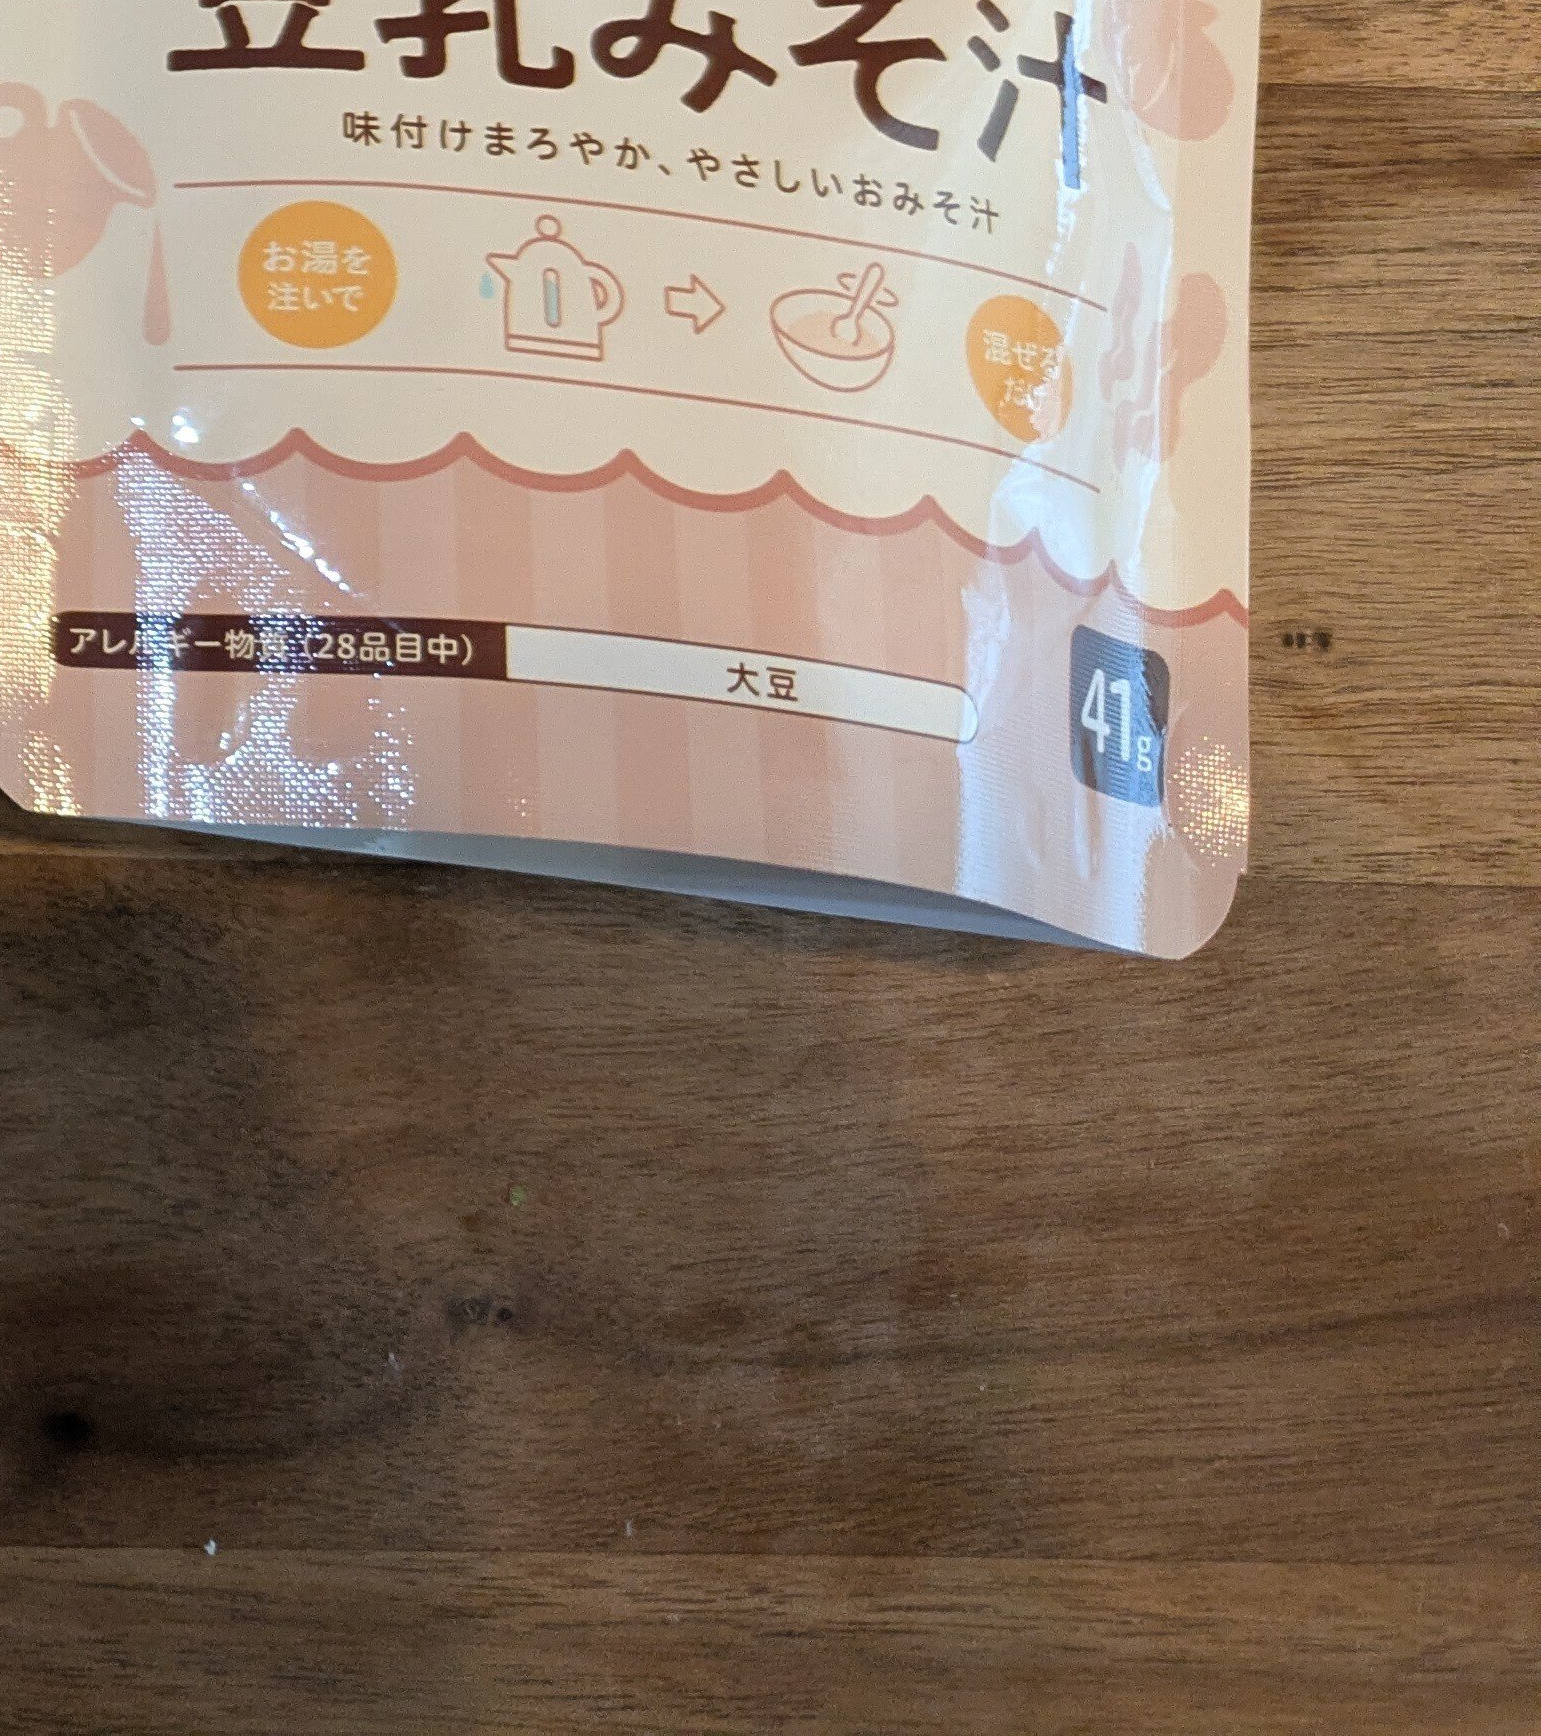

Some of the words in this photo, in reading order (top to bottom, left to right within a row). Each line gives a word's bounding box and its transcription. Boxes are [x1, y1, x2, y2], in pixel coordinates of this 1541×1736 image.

[341, 110, 1001, 234] 味付けまろやか、やさしいおみそ汁
[260, 238, 372, 276] お湯を
[266, 282, 364, 314] 注いで
[726, 660, 800, 703] 大豆
[1080, 667, 1153, 773] 41g
